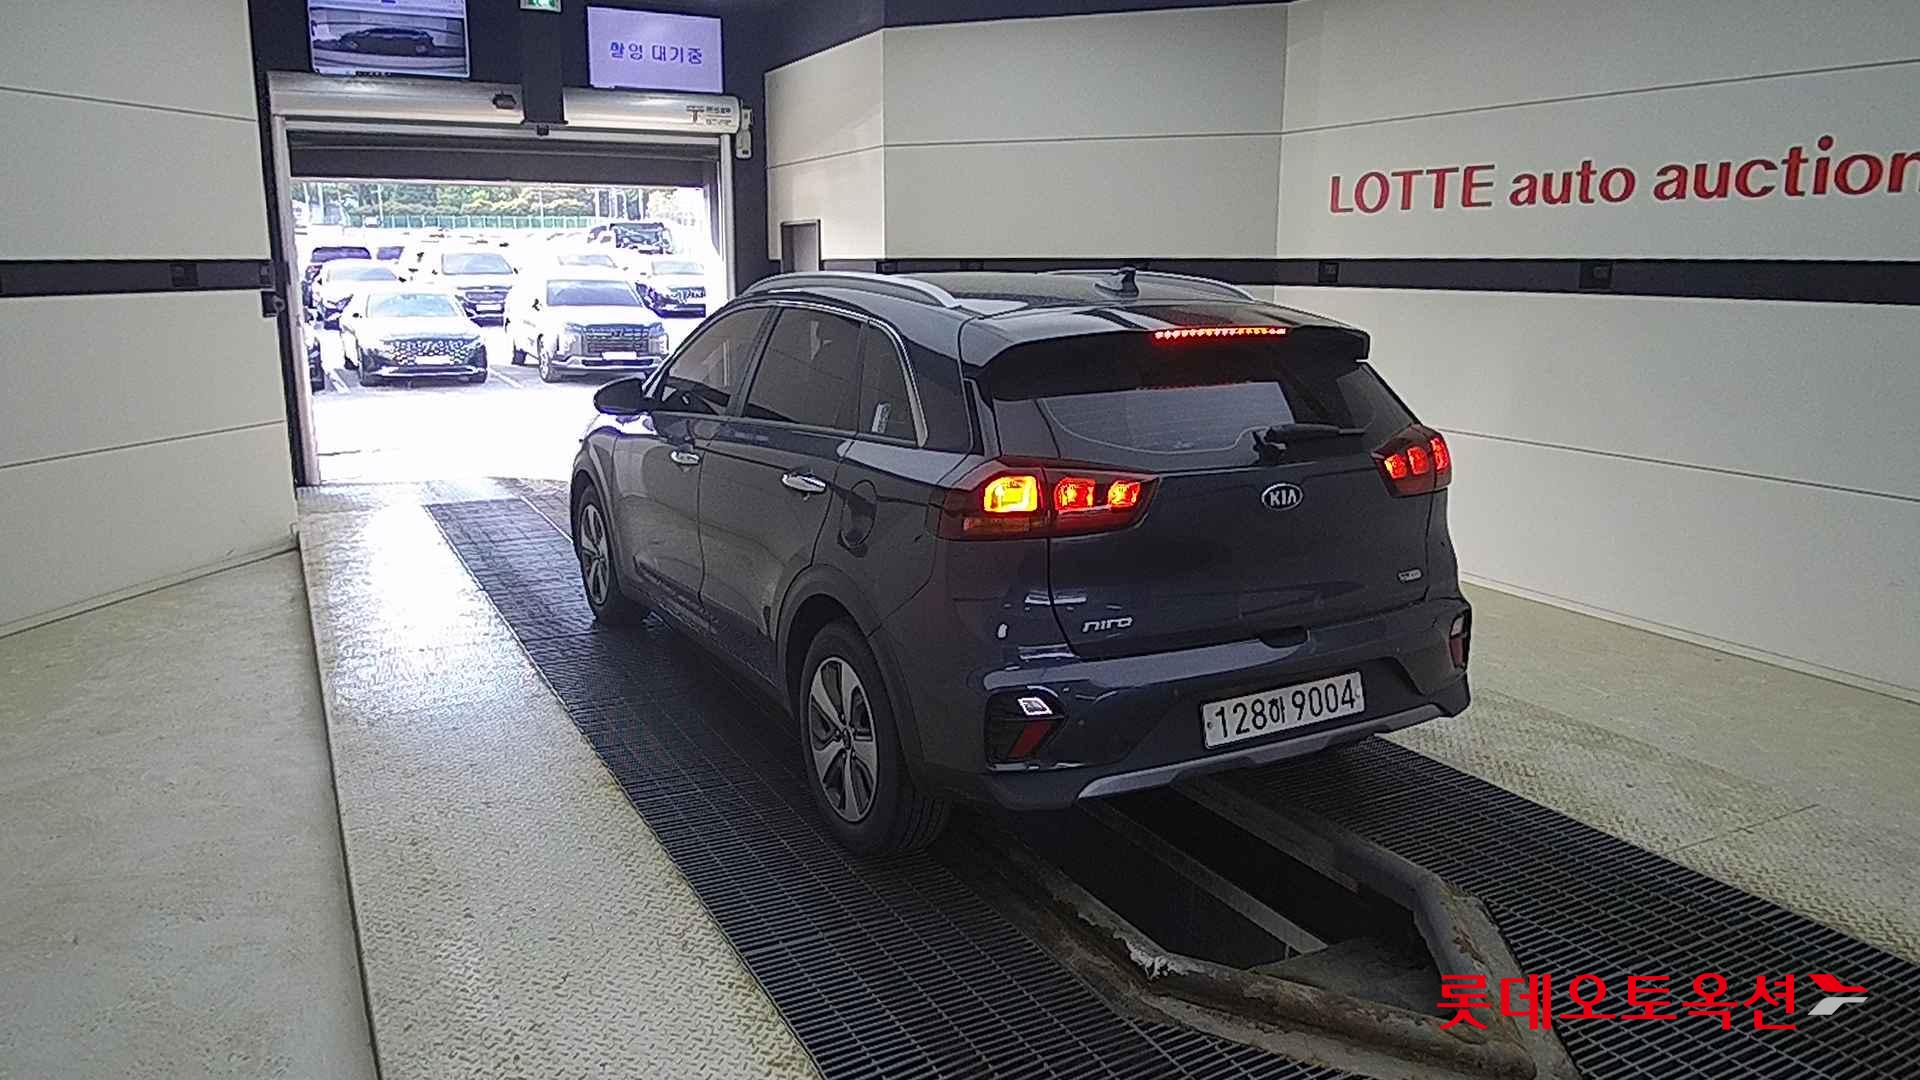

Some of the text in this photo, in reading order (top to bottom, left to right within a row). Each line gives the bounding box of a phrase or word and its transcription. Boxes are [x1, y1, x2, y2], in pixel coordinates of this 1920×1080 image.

[652, 44, 703, 65] 대기중
[1329, 163, 1496, 214] LOTTE
[1509, 159, 1636, 206] auto
[1267, 486, 1298, 508] KIA
[1215, 678, 1356, 739] 128하 9004
